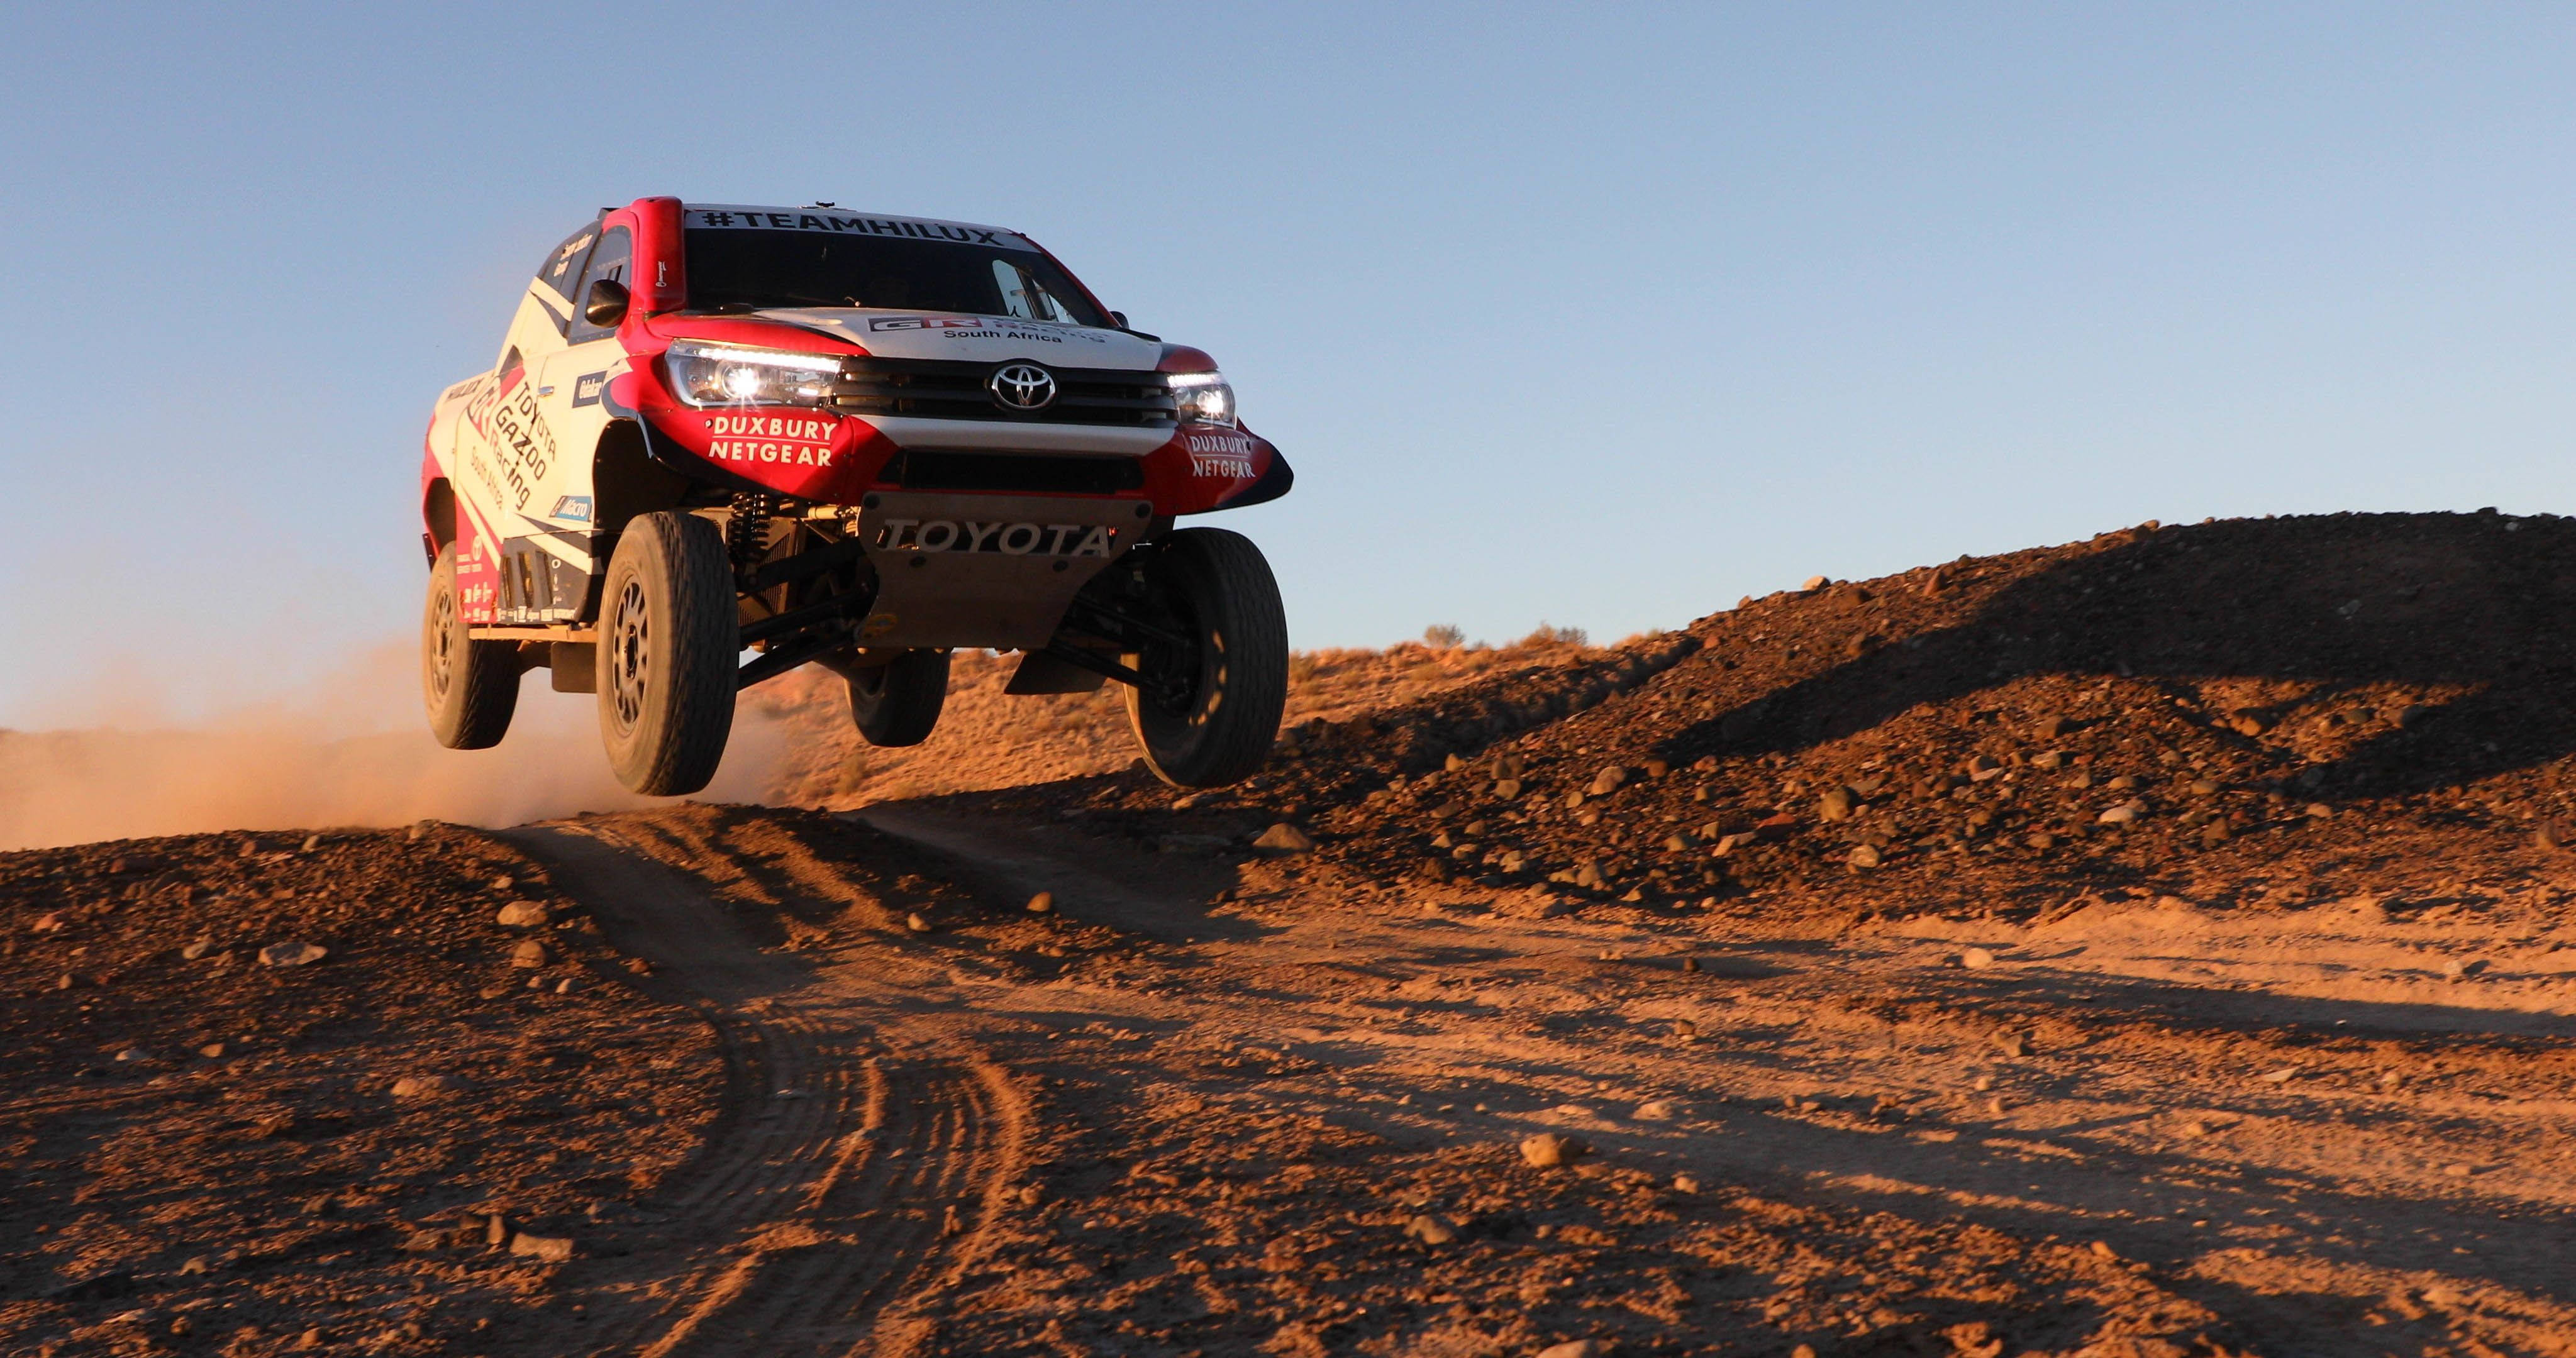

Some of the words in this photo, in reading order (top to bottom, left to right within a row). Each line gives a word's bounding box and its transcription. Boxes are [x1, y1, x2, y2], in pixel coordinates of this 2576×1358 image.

[702, 212, 1004, 246] #TEAMHILUX
[869, 316, 982, 332] GR
[943, 330, 1001, 338] South
[1006, 331, 1062, 343] Africa
[514, 381, 556, 462] TOYOTA
[714, 416, 837, 440] DUXBURY
[496, 406, 547, 481] GAZOO
[708, 441, 831, 466] NETGEAR
[1189, 435, 1248, 454] DUXBURY
[490, 427, 531, 511] Racing
[1192, 460, 1256, 478] NETGEAR
[879, 519, 1110, 558] TOYOTA
